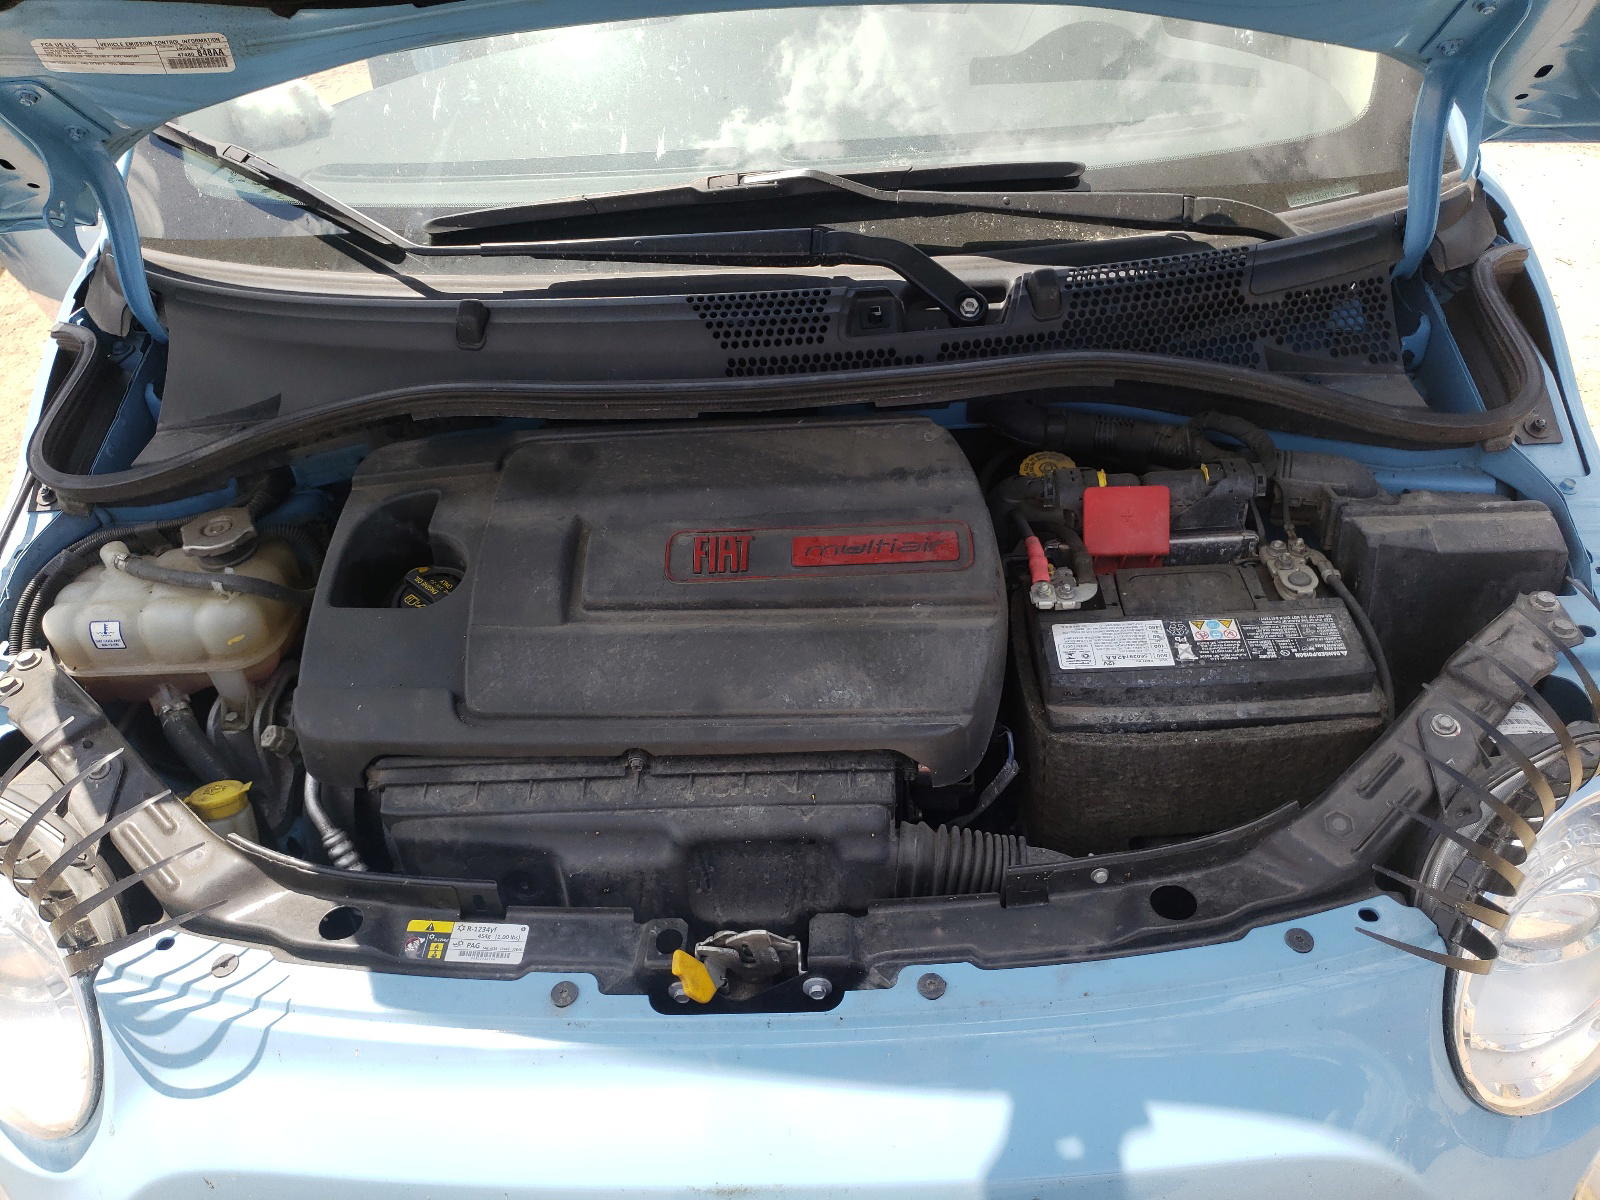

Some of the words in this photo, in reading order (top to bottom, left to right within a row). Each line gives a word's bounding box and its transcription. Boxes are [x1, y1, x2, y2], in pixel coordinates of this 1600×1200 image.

[197, 48, 225, 57] 848AA
[804, 537, 946, 557] multiair
[692, 535, 753, 575] FIAT
[466, 925, 498, 934] R-1234yf
